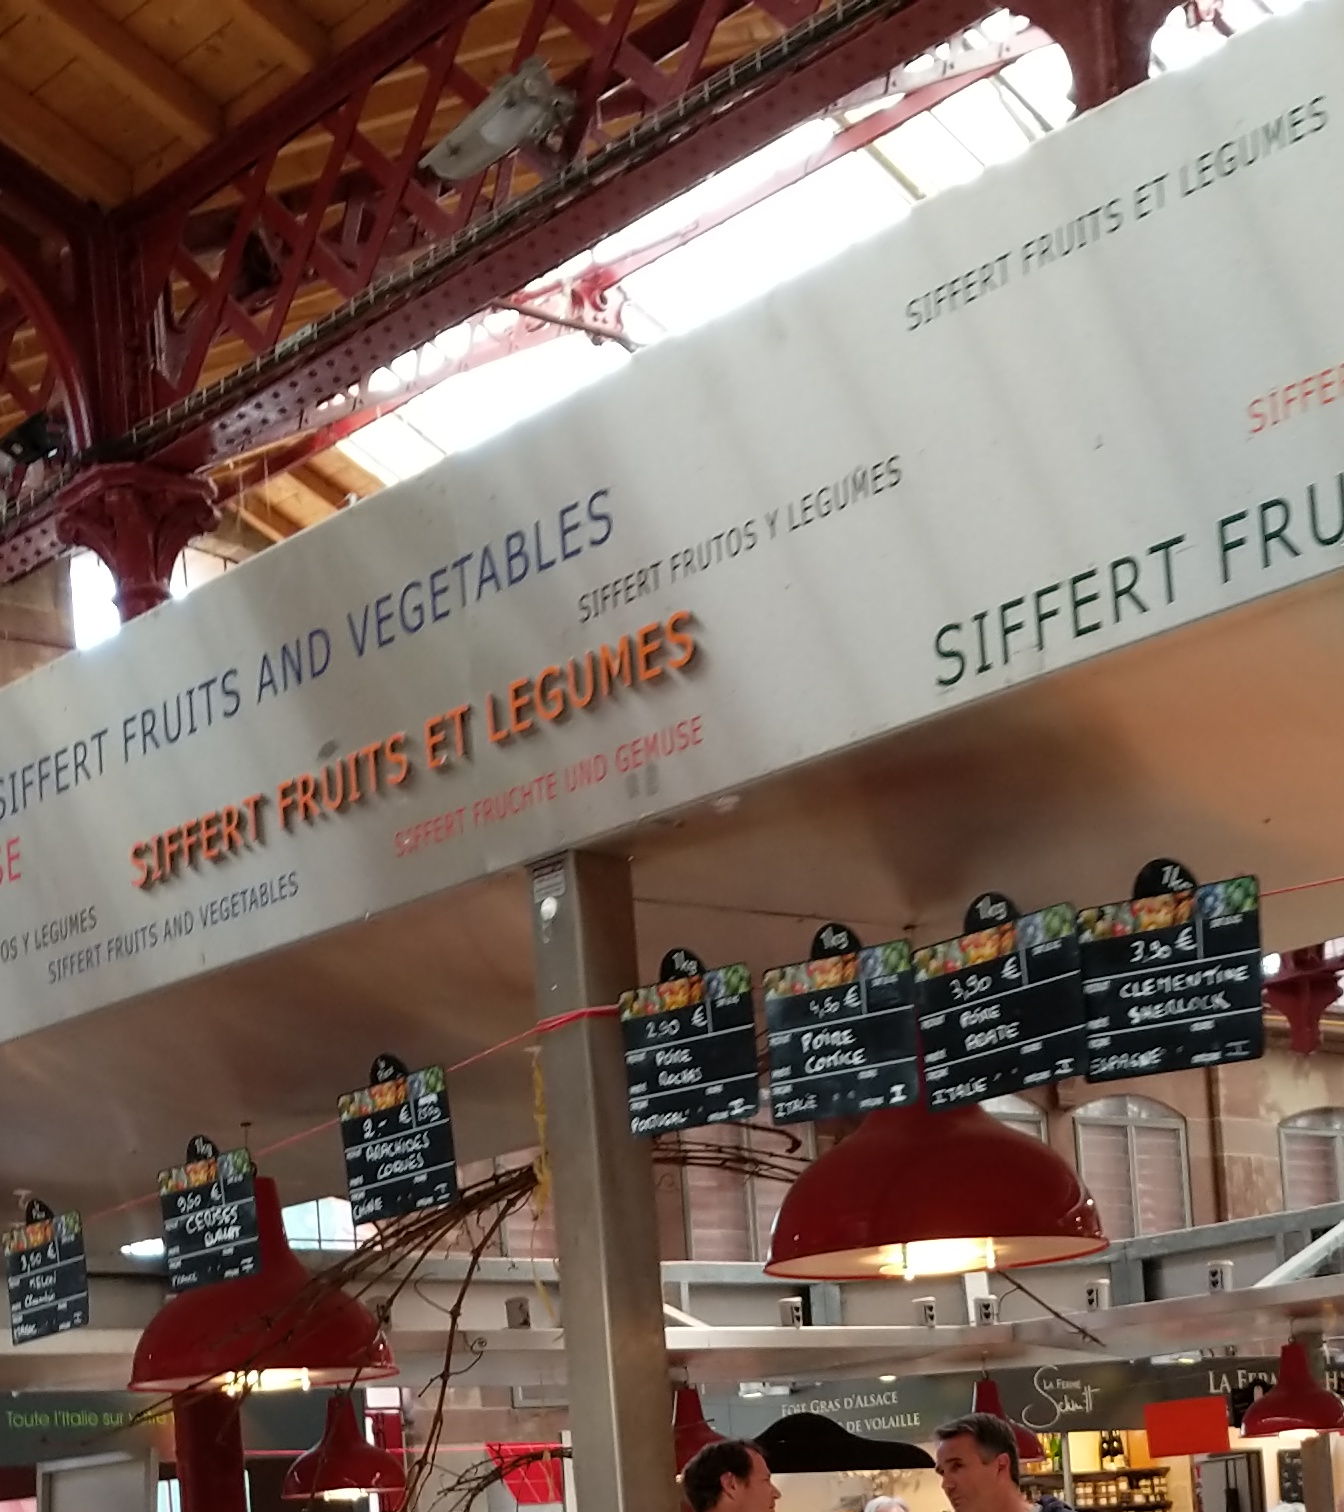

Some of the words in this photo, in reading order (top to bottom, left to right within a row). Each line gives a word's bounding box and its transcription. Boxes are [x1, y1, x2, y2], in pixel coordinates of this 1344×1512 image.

[905, 254, 1012, 333] SIFFERT
[1021, 198, 1123, 276] FRUITS
[1132, 175, 1172, 219] ET
[1180, 95, 1330, 198] LEGUMES
[578, 561, 662, 625] SIFFERT
[670, 519, 758, 583] FRUTOS
[765, 510, 780, 539] Y
[788, 455, 902, 532] LEGUMES
[123, 669, 240, 762] FRUITS
[256, 627, 331, 706] AND
[347, 488, 613, 659] VEGETABLES
[933, 533, 1188, 691] SIFFERT
[130, 792, 263, 890] SIFFERT
[278, 730, 409, 830] FRUITS
[426, 703, 471, 768] ET
[487, 610, 698, 745] LEGUMES
[394, 802, 467, 857] SIFFERT
[472, 772, 558, 834] FRUCHTE
[563, 753, 607, 796] UND
[614, 715, 704, 775] GEMUSE
[21, 935, 31, 959] Y
[34, 906, 97, 951] LEGUMES
[47, 942, 101, 985] SIFFERT
[105, 925, 159, 971] FRUITS
[163, 912, 195, 949] AND
[200, 871, 300, 930] VEGETABLES
[7, 1410, 50, 1428] Toute
[810, 1397, 841, 1415] GRAS
[864, 1411, 921, 1431] VOLAILLE
